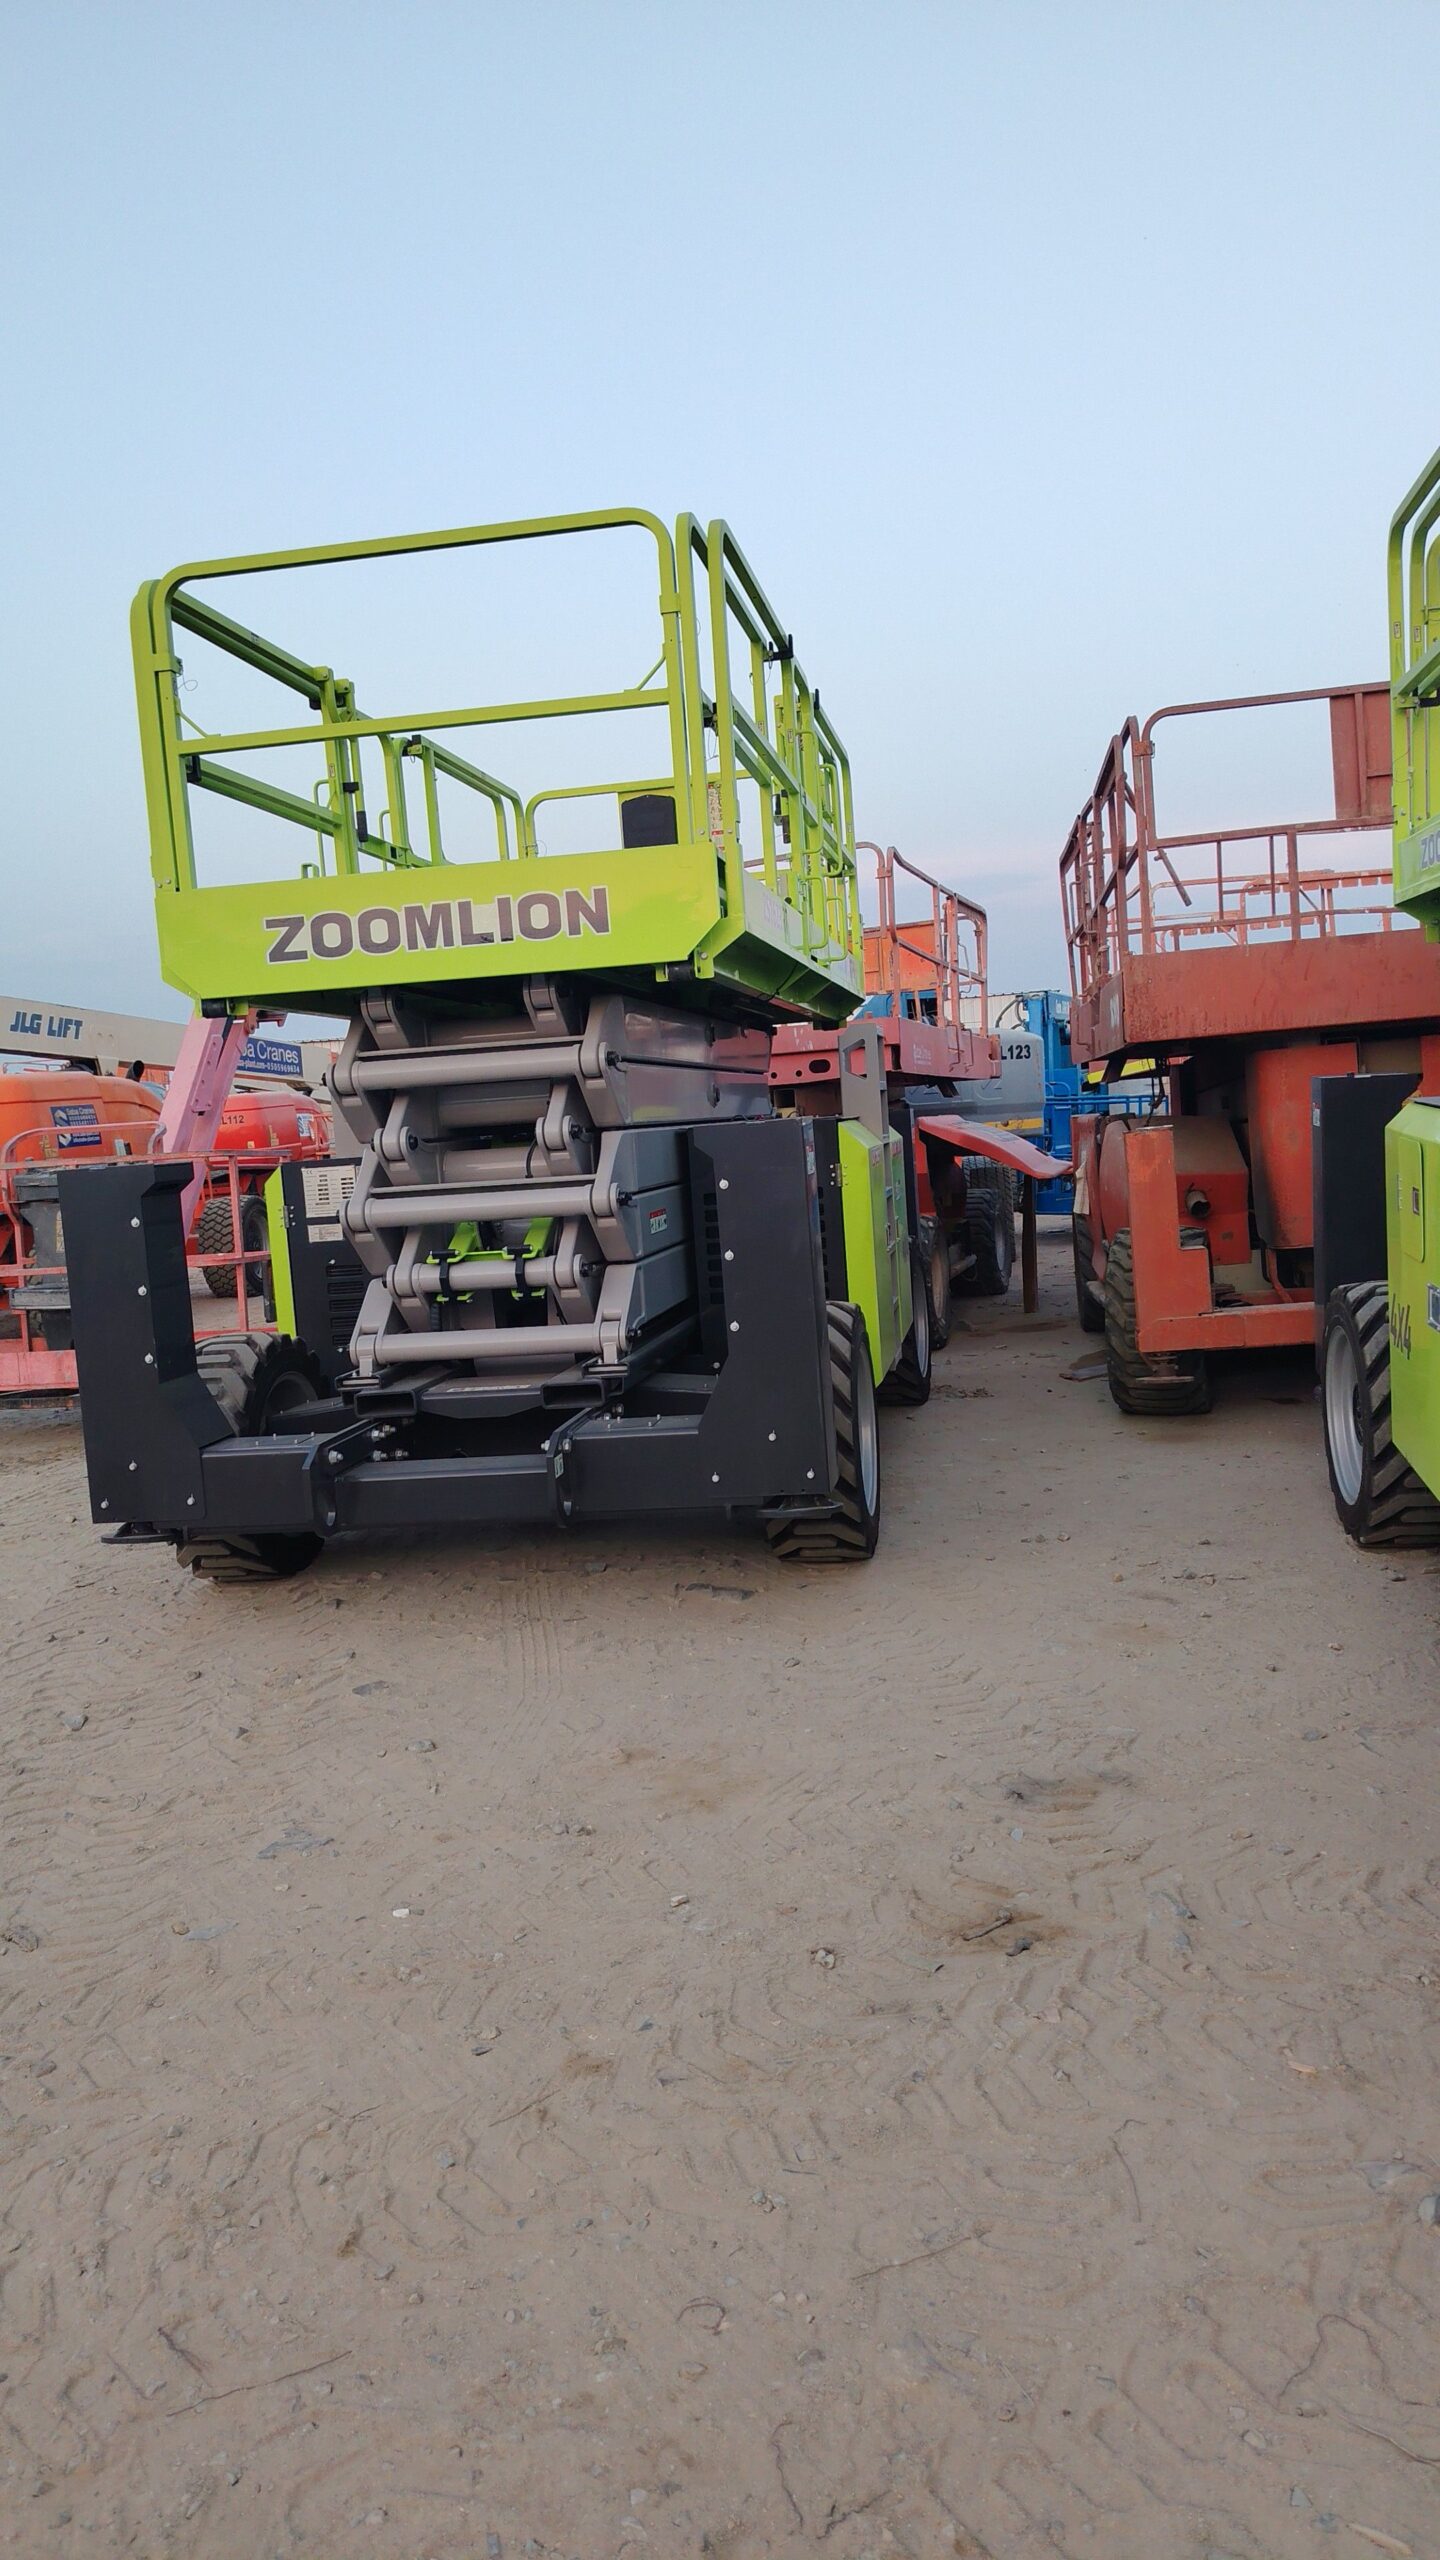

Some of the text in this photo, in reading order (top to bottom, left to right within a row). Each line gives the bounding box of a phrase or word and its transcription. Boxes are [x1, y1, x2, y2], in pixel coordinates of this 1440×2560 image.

[264, 886, 610, 964] ZOOMLION
[10, 1011, 83, 1040] JLG LIFT
[256, 1041, 299, 1064] Cranes
